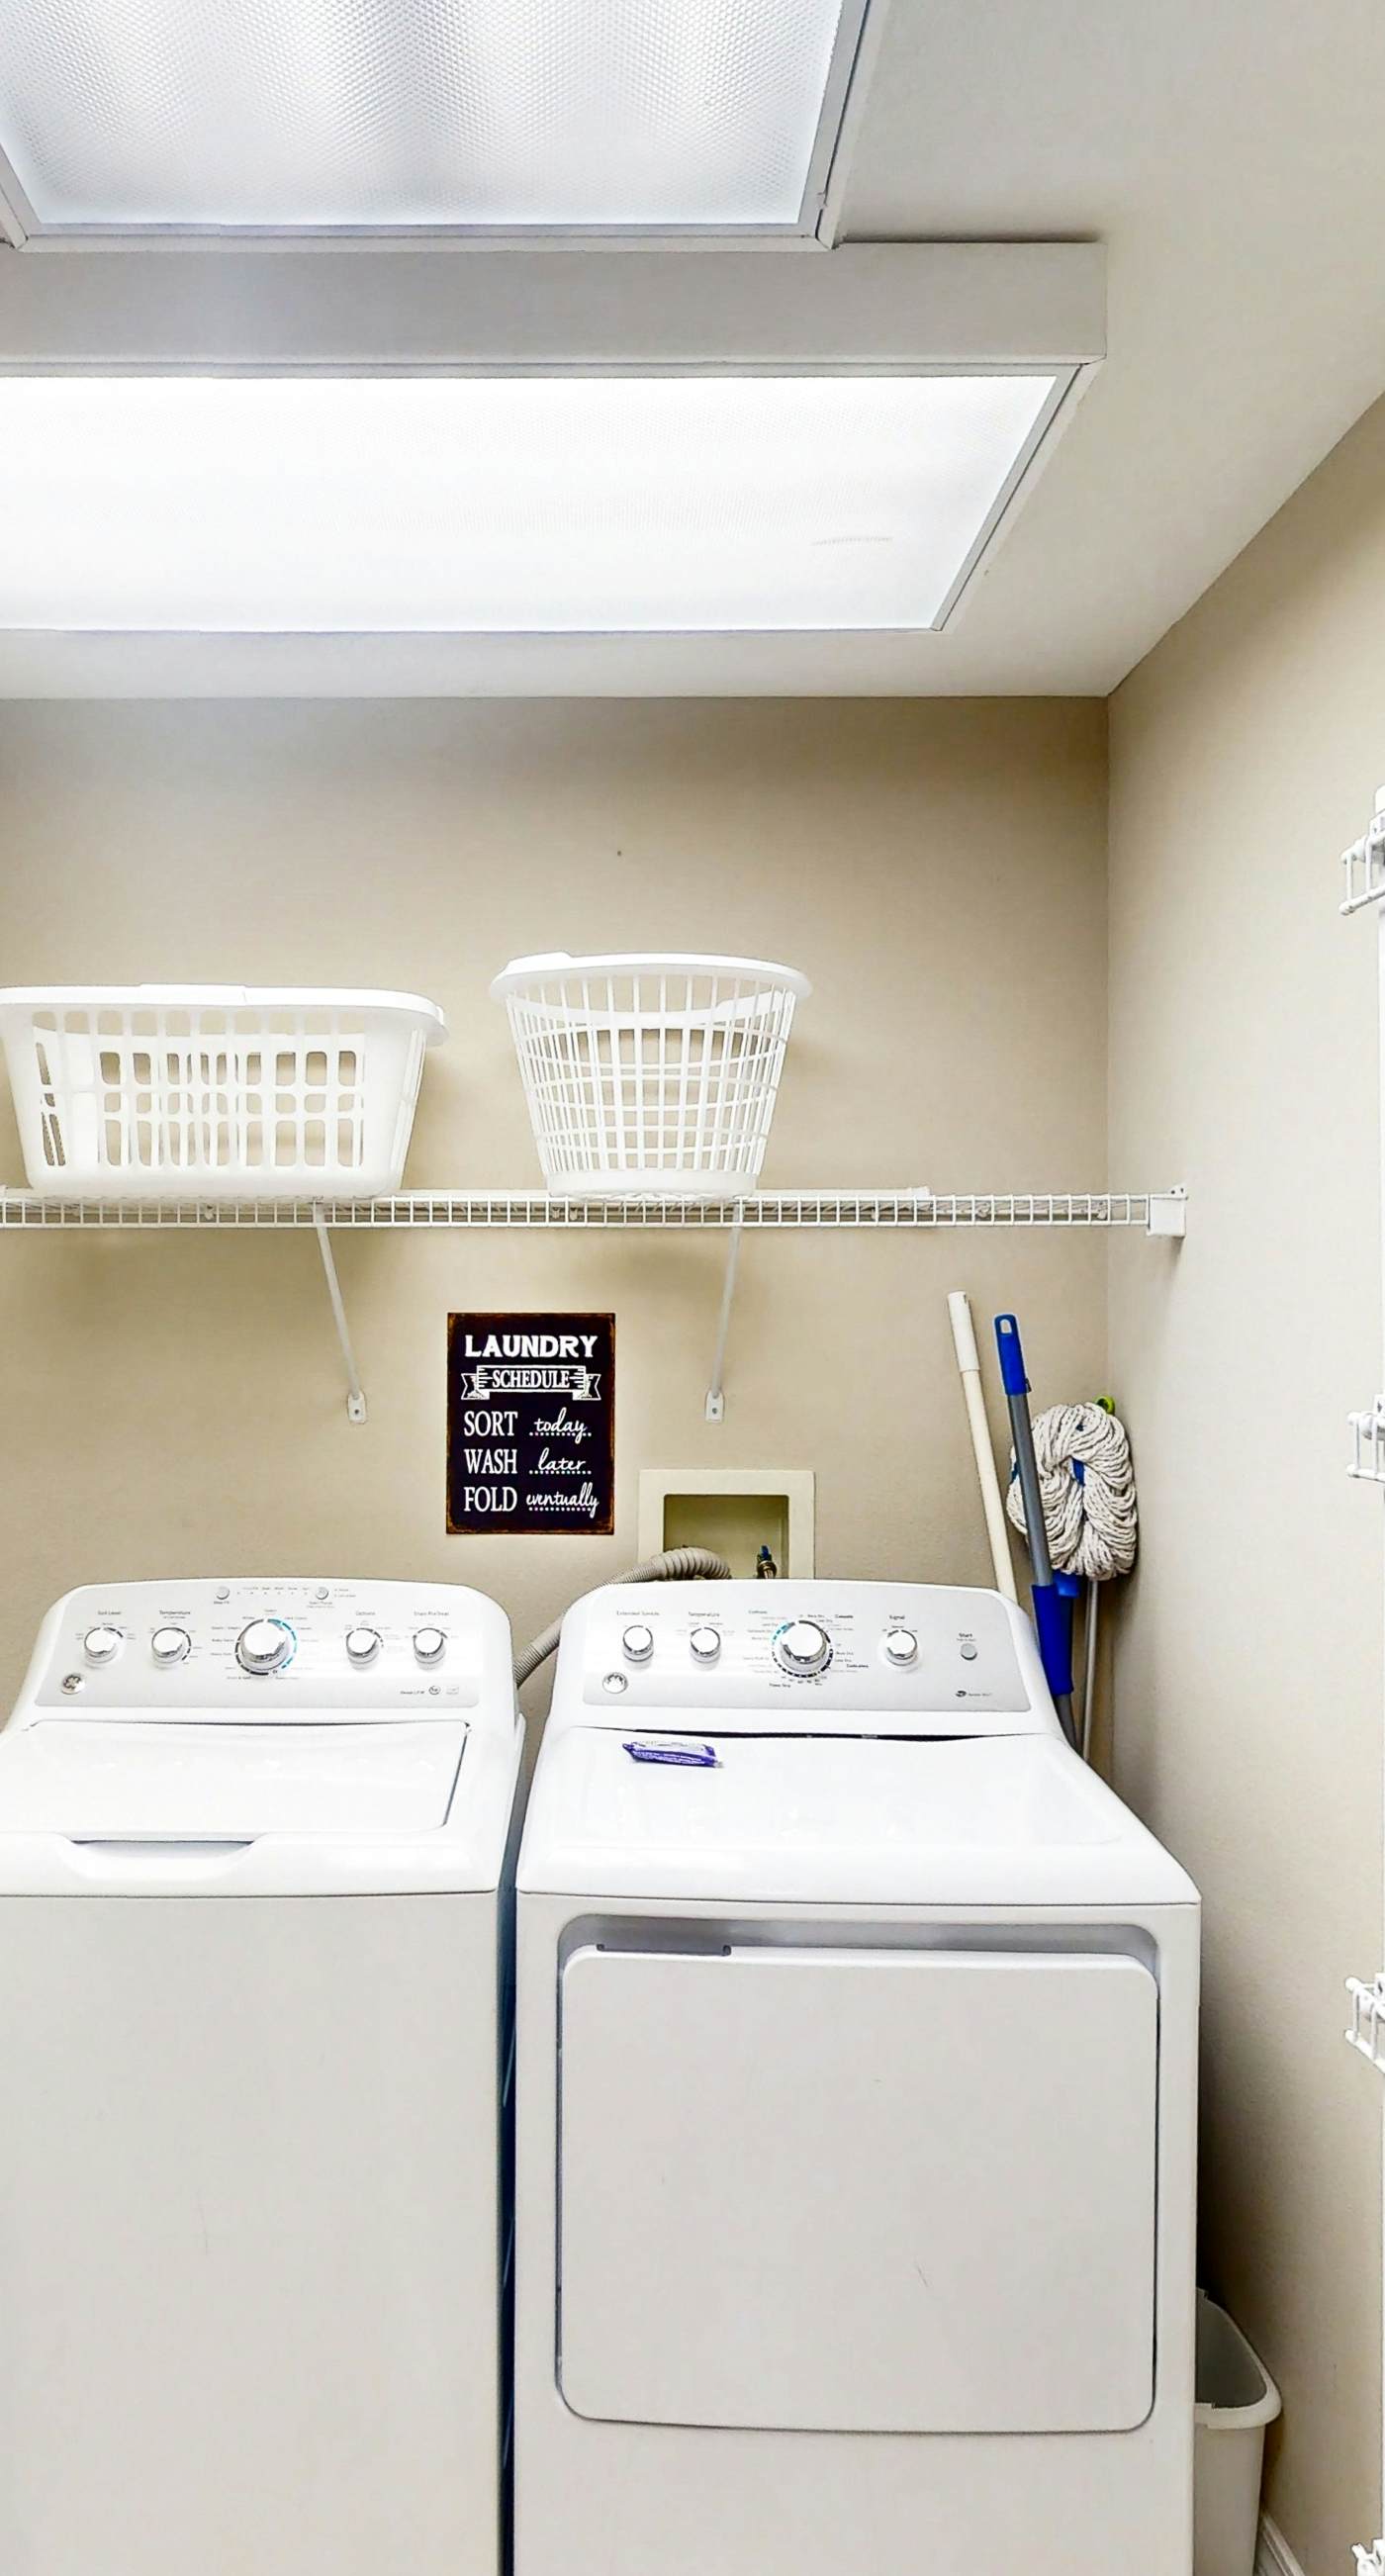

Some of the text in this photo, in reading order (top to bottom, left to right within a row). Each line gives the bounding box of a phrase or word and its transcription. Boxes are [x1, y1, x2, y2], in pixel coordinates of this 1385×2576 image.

[464, 1334, 598, 1358] LAUNDRY
[492, 1369, 571, 1389] SCHEDULE
[463, 1407, 588, 1444] SORT today
[463, 1447, 587, 1474] WASH later
[463, 1482, 600, 1518] FOLD eventually
